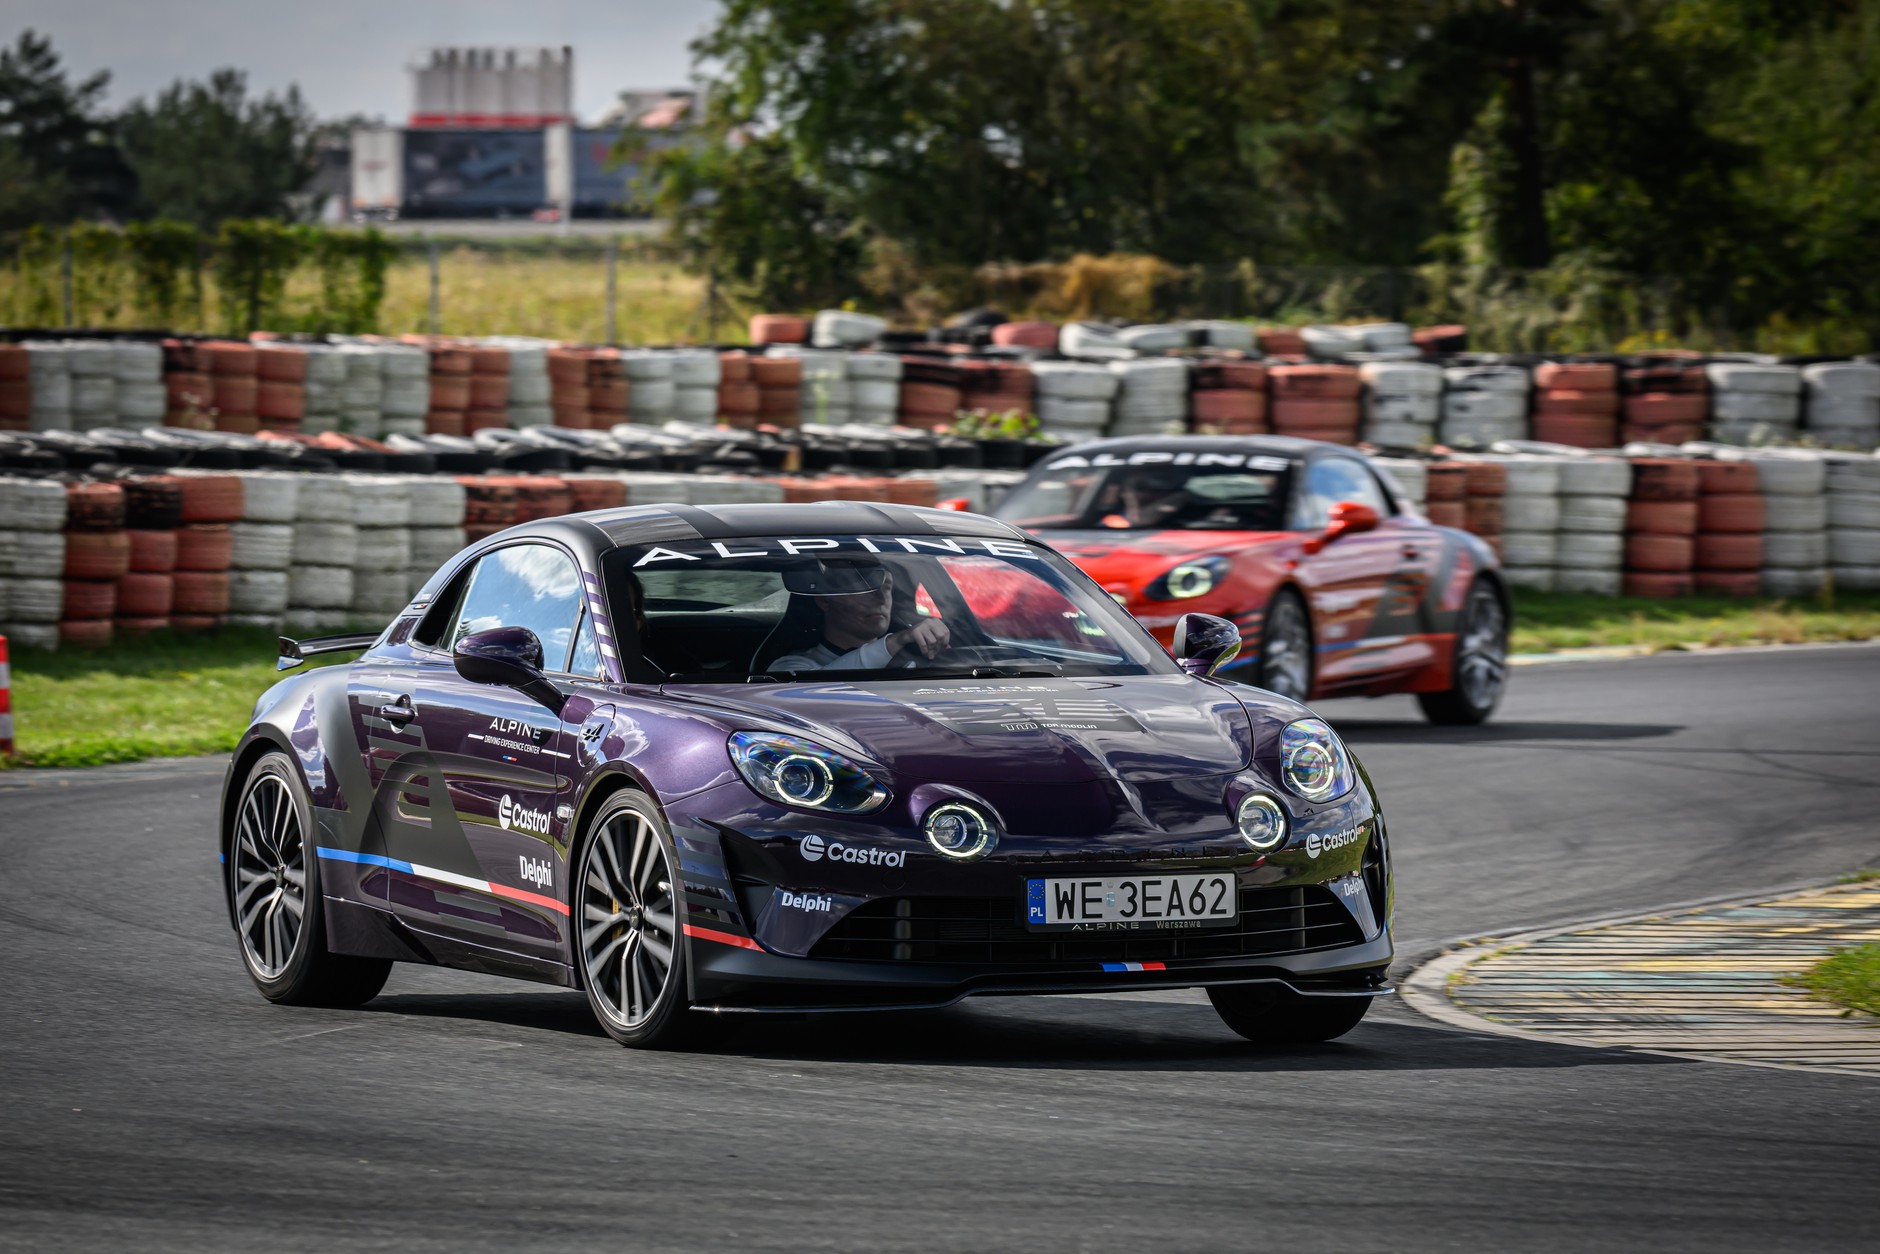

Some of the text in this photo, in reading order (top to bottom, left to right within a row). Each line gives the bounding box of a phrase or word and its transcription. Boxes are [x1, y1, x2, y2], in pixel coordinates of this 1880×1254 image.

[1047, 453, 1290, 471] ALPINE
[633, 538, 1039, 568] ALPINE
[489, 717, 541, 740] ALPINE
[484, 735, 540, 755] DRIVING EXPERIENCE CENTER
[512, 803, 552, 834] Castrol
[1323, 825, 1358, 851] Castrol
[827, 842, 906, 868] Castrol
[519, 855, 552, 889] Delphi
[781, 892, 832, 912] Delphi
[1054, 878, 1227, 920] WE 3EA62
[1030, 907, 1044, 917] PL
[1071, 919, 1201, 931] ALPINE Warszawa
